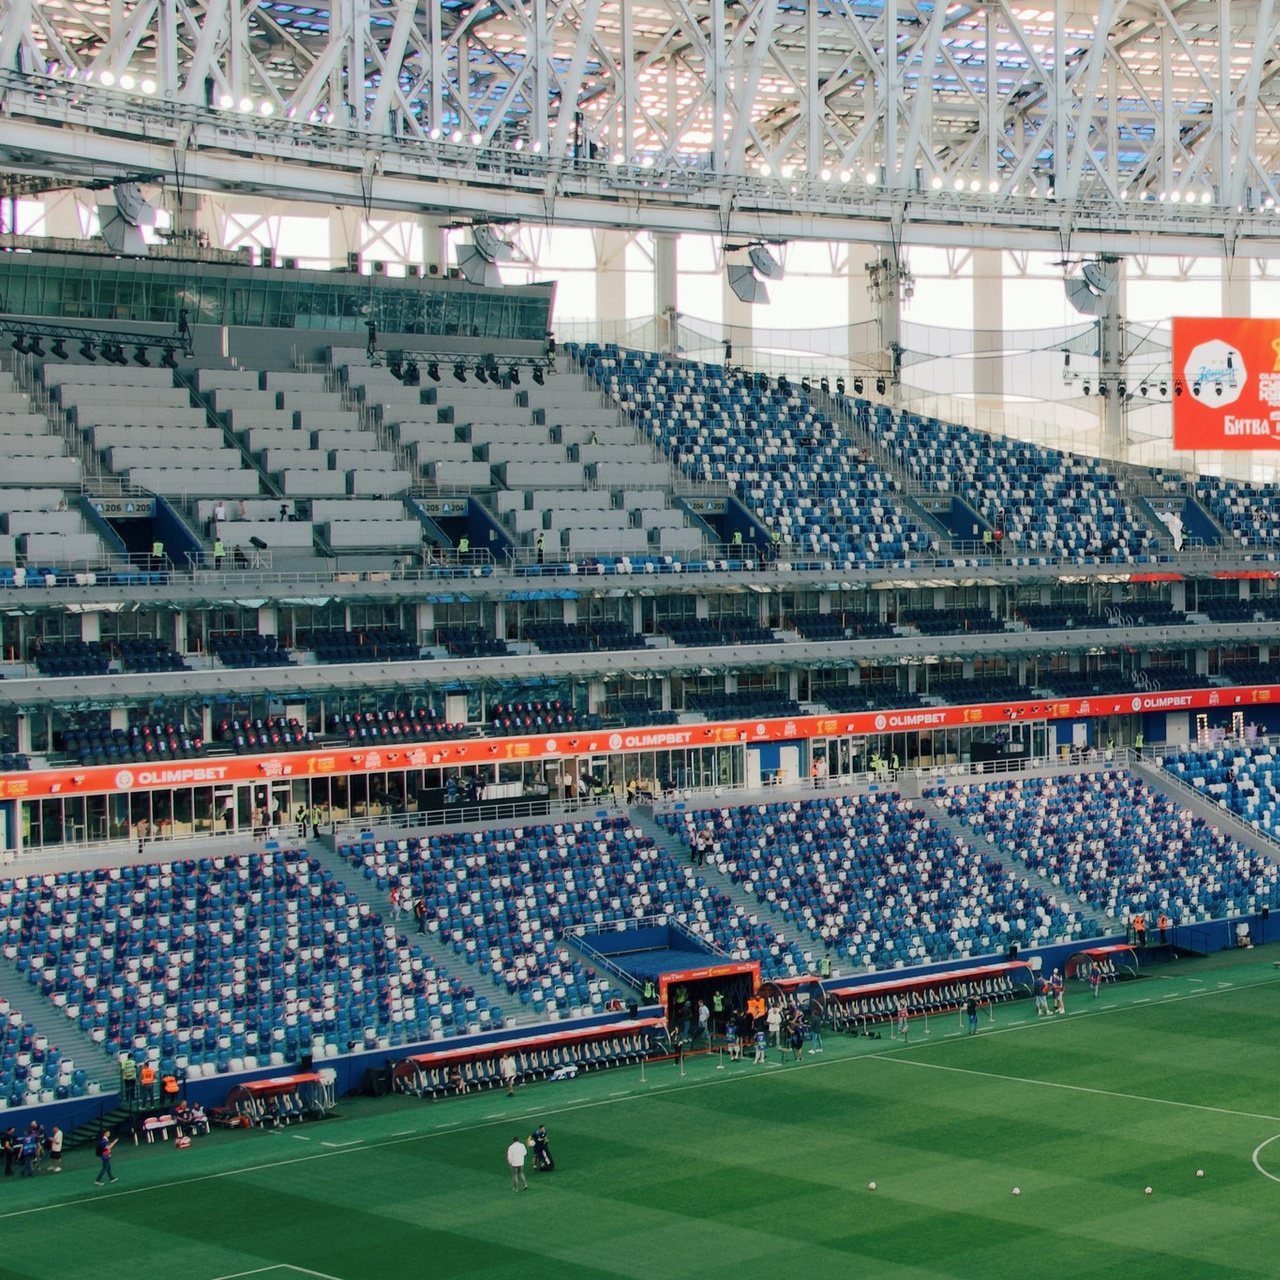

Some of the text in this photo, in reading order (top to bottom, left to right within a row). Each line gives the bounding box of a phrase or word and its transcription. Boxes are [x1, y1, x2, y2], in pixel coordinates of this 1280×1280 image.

[136, 504, 151, 512] 205
[1144, 696, 1193, 707] OLIMPBET
[889, 712, 947, 727] OLIMPBET
[625, 732, 692, 748] OLIMPBET
[138, 766, 228, 785] OLIMPBET
